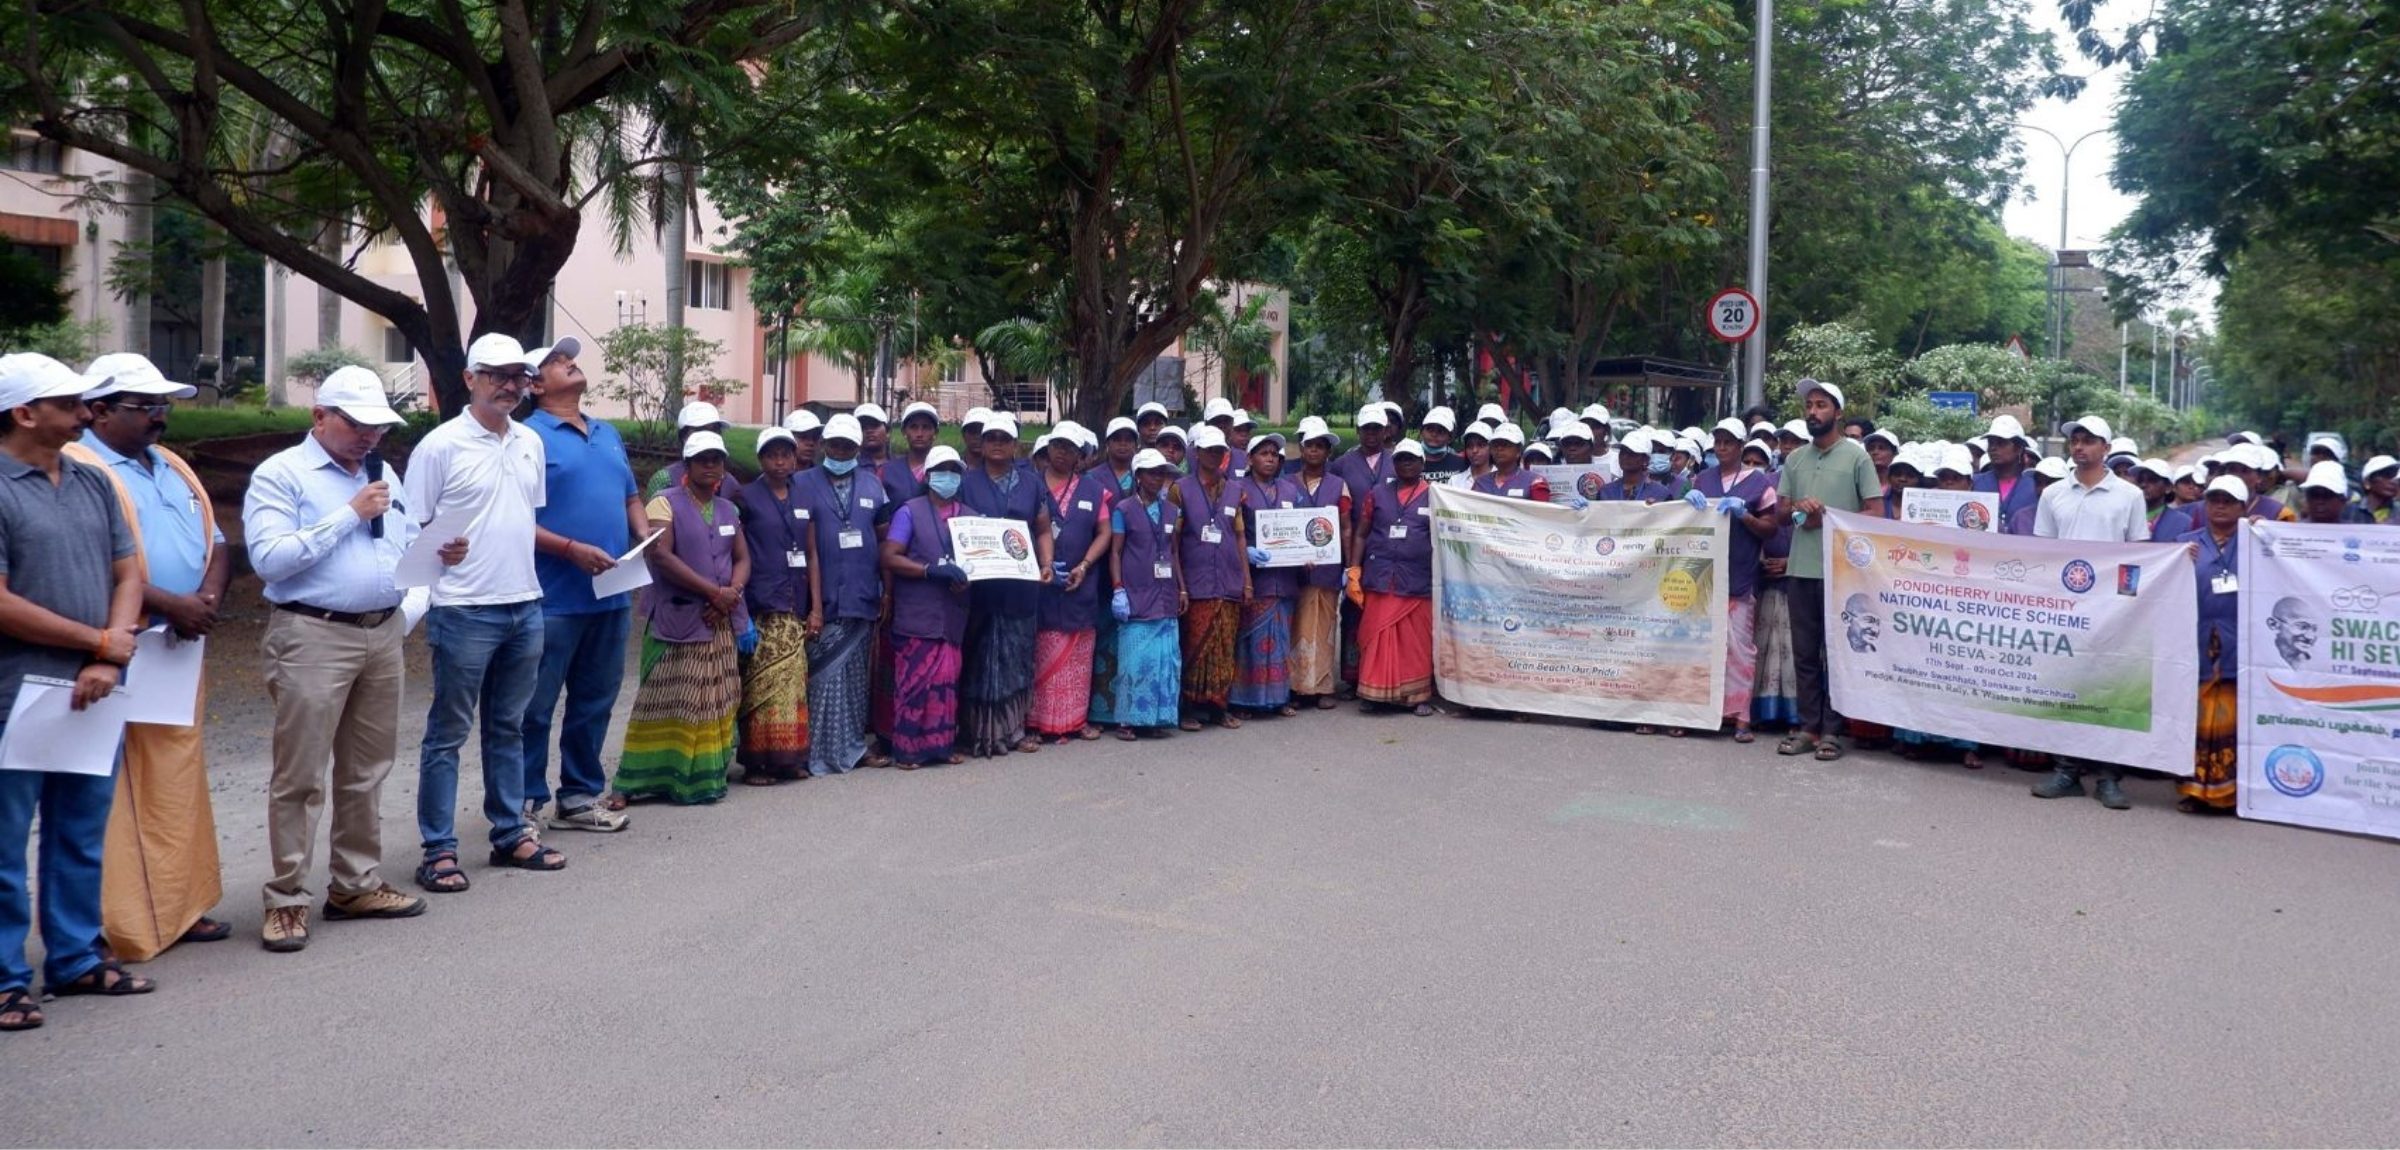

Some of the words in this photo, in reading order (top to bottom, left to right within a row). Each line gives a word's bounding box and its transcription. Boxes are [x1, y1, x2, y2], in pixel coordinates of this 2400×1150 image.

[1723, 308, 1744, 323] 20
[1893, 579, 1990, 600] PONDICHERRY
[1994, 591, 2077, 611] UNIVERSITY
[1880, 592, 1952, 611] NATIONAL
[1956, 601, 2021, 621] SERVICE
[2026, 610, 2090, 630] SCHEME
[1893, 611, 2074, 657] SWACHHATA
[1929, 642, 1943, 655] HI
[1947, 644, 1985, 660] SEVA
[1998, 652, 2033, 666] 2024
[2331, 641, 2355, 661] HI
[1507, 659, 1535, 670] Clean
[1536, 662, 1571, 673] Beach!
[1572, 664, 1590, 674] Our
[1592, 666, 1620, 677] Pride!
[1925, 657, 1942, 667] 17th
[1945, 661, 1964, 671] Sept
[1974, 666, 1996, 675] 02nd
[1997, 669, 2014, 678] Oct
[2016, 671, 2038, 681] 2024
[1946, 683, 1969, 696] Rally,
[1972, 688, 1978, 696] &
[2011, 695, 2021, 703] to
[2060, 701, 2109, 714] Exhibition
[2025, 686, 2077, 700] Swachhata
[2343, 775, 2361, 786] for
[2364, 777, 2381, 788] the
